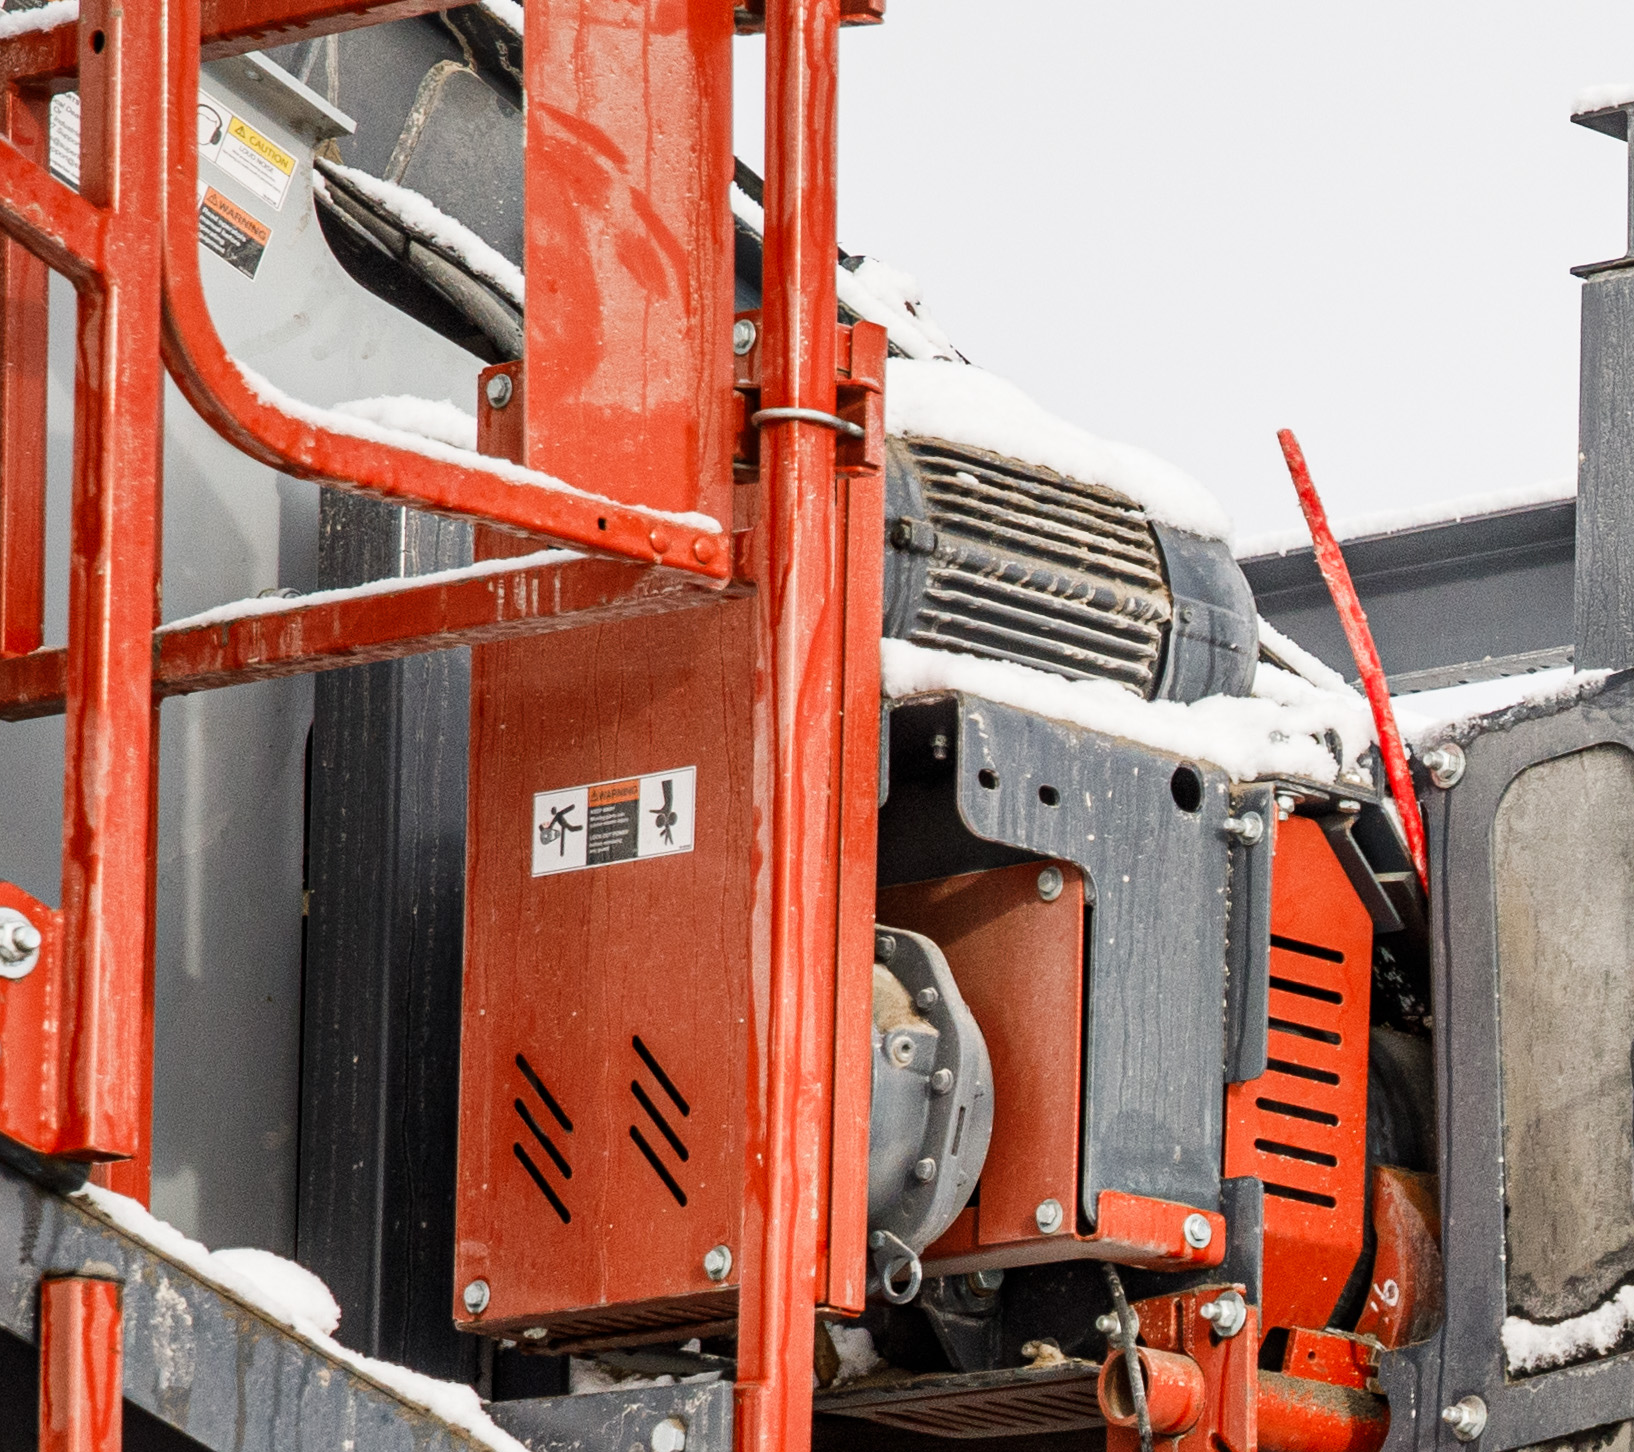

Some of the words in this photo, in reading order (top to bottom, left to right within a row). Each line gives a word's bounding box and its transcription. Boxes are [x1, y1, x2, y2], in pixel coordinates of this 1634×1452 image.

[248, 135, 289, 168] CAUTION
[219, 203, 267, 241] WARNING
[599, 786, 638, 800] WARNING
